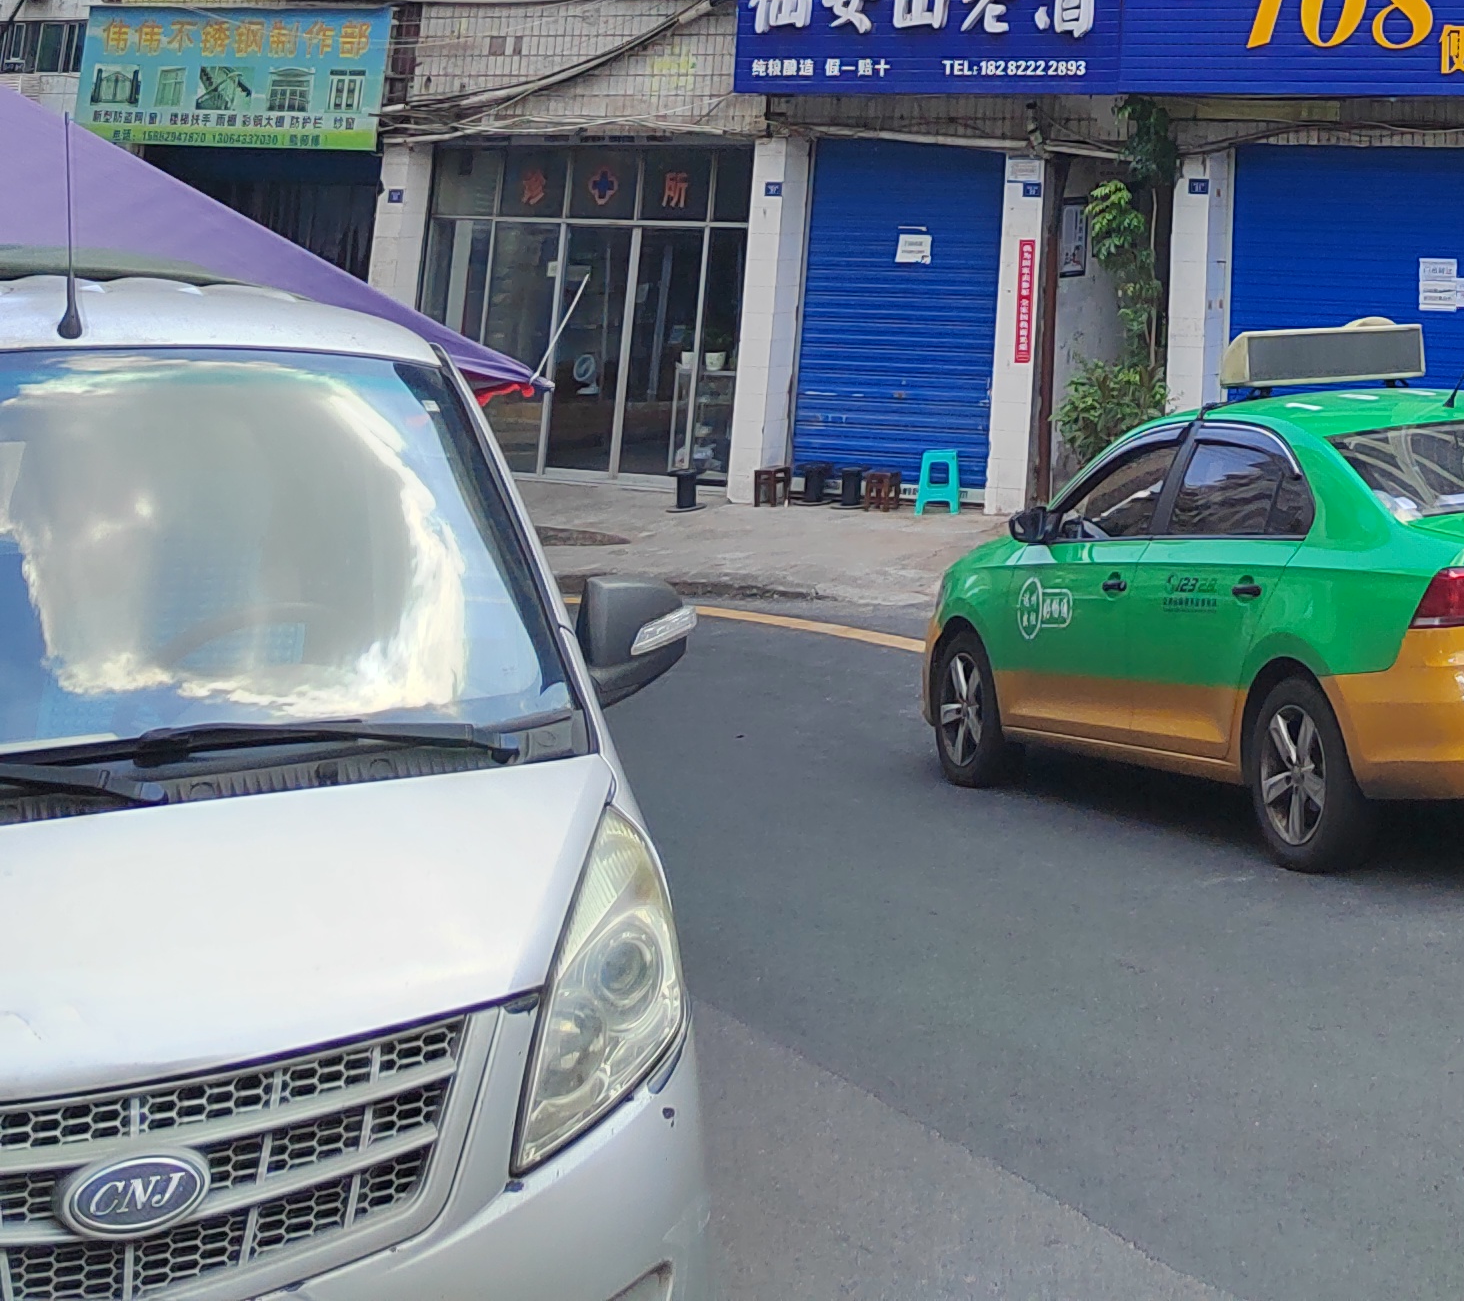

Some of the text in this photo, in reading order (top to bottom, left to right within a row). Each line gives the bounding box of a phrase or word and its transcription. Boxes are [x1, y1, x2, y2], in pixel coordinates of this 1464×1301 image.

[103, 17, 372, 59] 伟伟不锈钢制作部
[752, 58, 814, 77] 纯粮酿造
[825, 58, 890, 77] 假一赔十
[89, 1171, 186, 1216] CNJ
